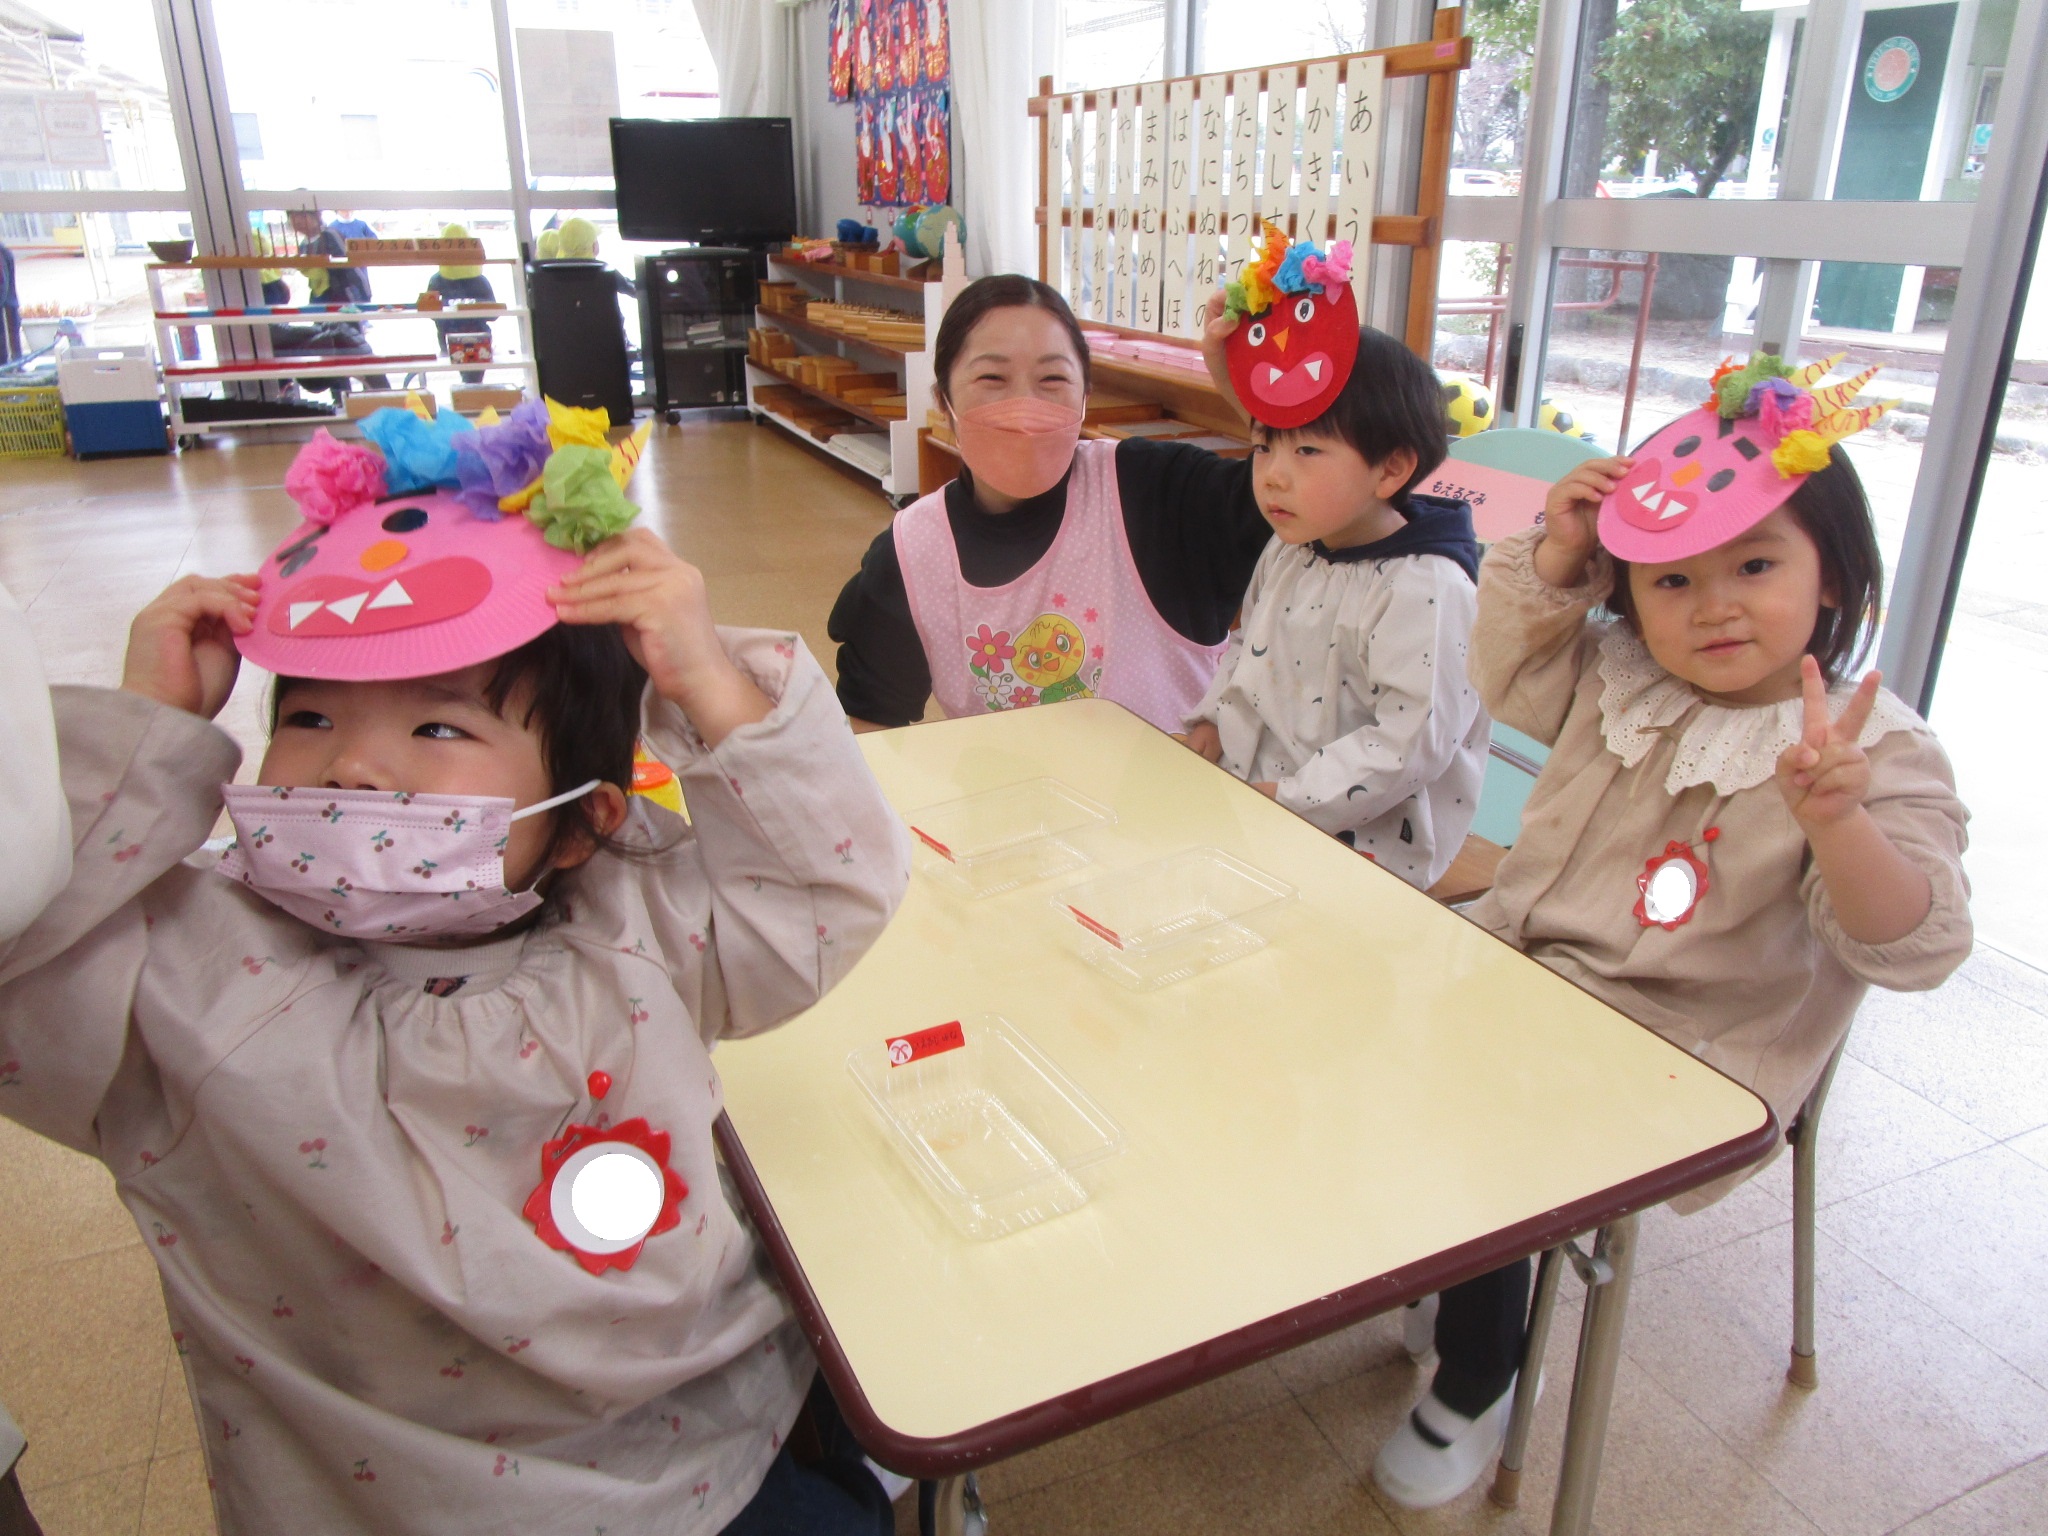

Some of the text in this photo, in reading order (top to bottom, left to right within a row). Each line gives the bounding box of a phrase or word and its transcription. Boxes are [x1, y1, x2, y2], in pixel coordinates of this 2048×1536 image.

[1141, 110, 1159, 322] まみむめも
[1167, 109, 1189, 328] はひふへほ
[1345, 90, 1372, 280] あいう
